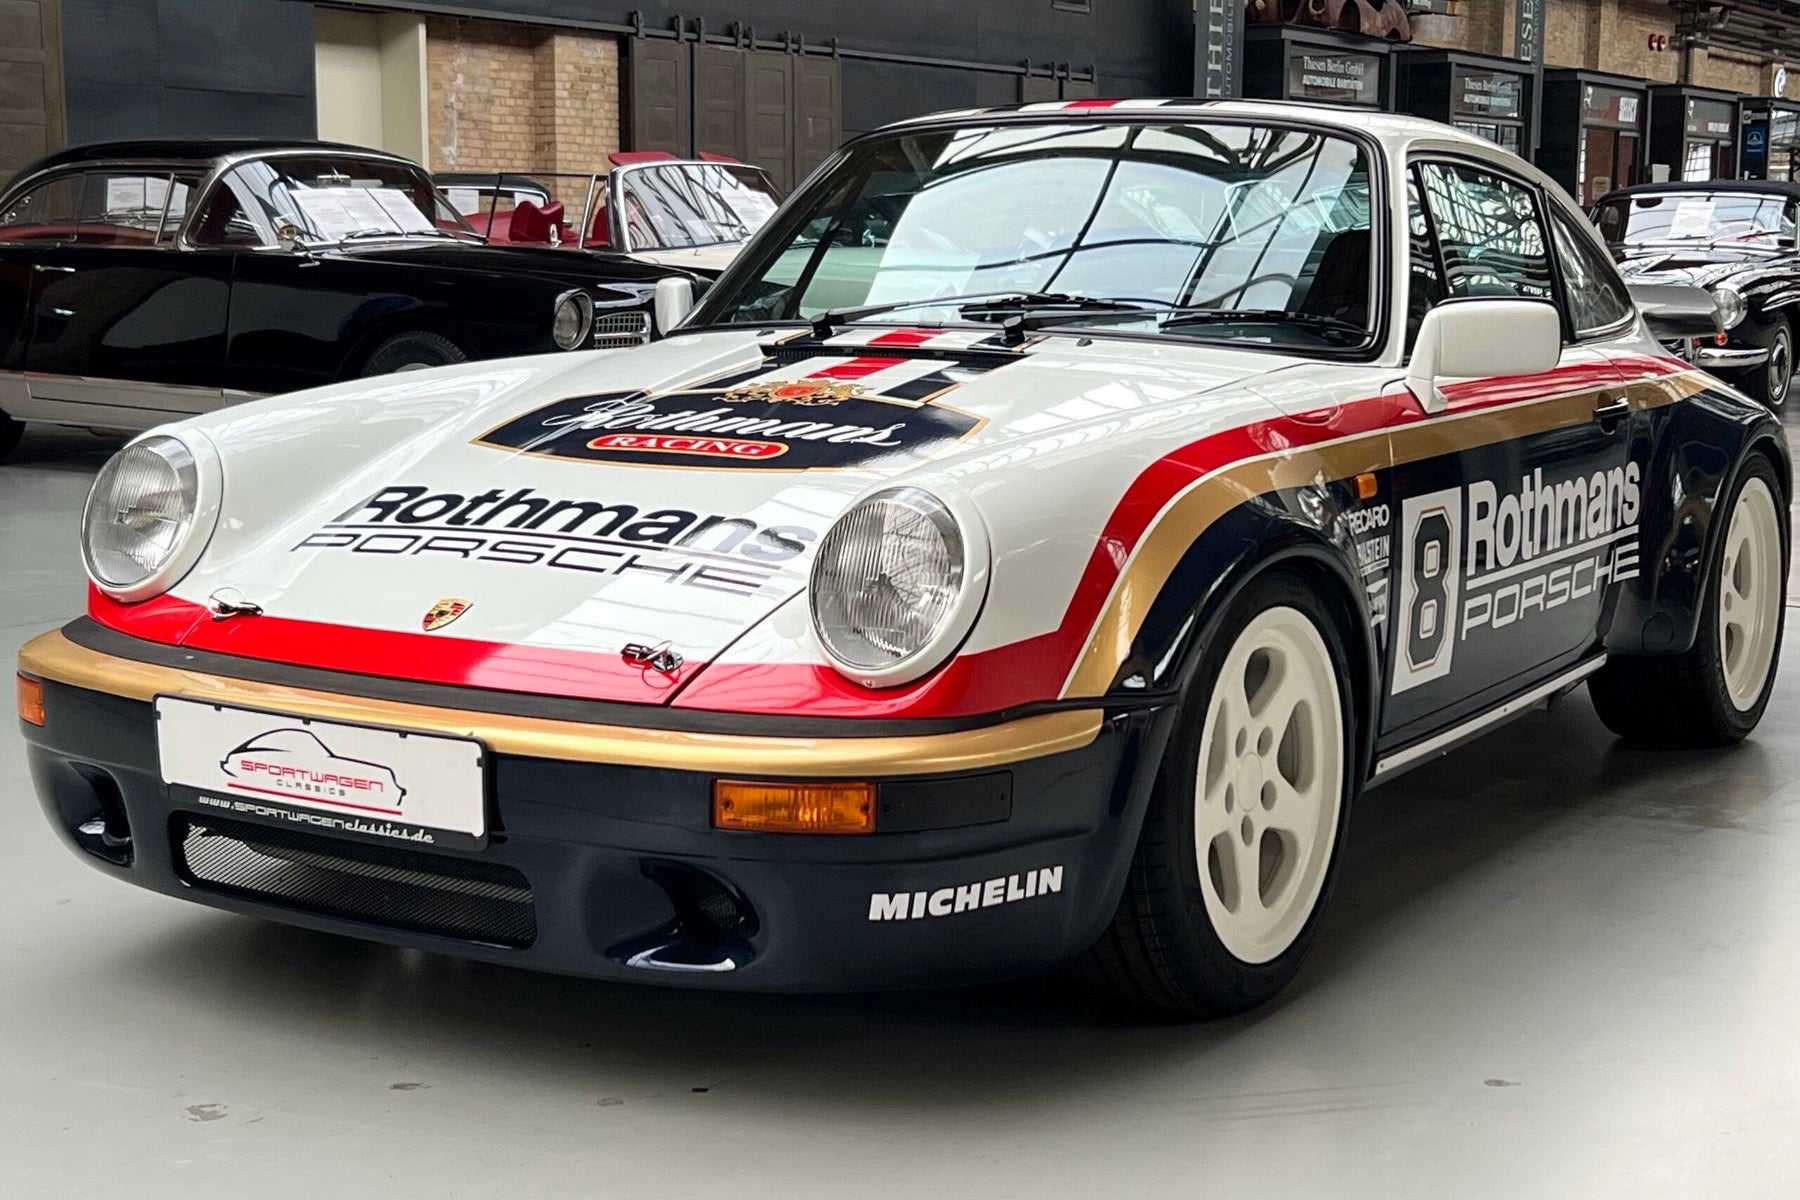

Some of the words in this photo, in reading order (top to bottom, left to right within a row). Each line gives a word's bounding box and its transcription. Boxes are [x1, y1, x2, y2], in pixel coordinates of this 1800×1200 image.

[542, 397, 906, 447] Rothmans
[606, 436, 770, 456] RACING
[331, 486, 818, 562] Rothmans
[1349, 504, 1390, 536] RECARO
[1466, 461, 1641, 577] Rothmans
[290, 533, 786, 597] PORSCHE
[1406, 506, 1453, 674] 8
[1461, 541, 1641, 642] PORSCHE
[240, 760, 384, 793] SPORTWAGEN
[276, 779, 346, 797] CLASSICS
[868, 865, 1064, 921] MICHELIN
